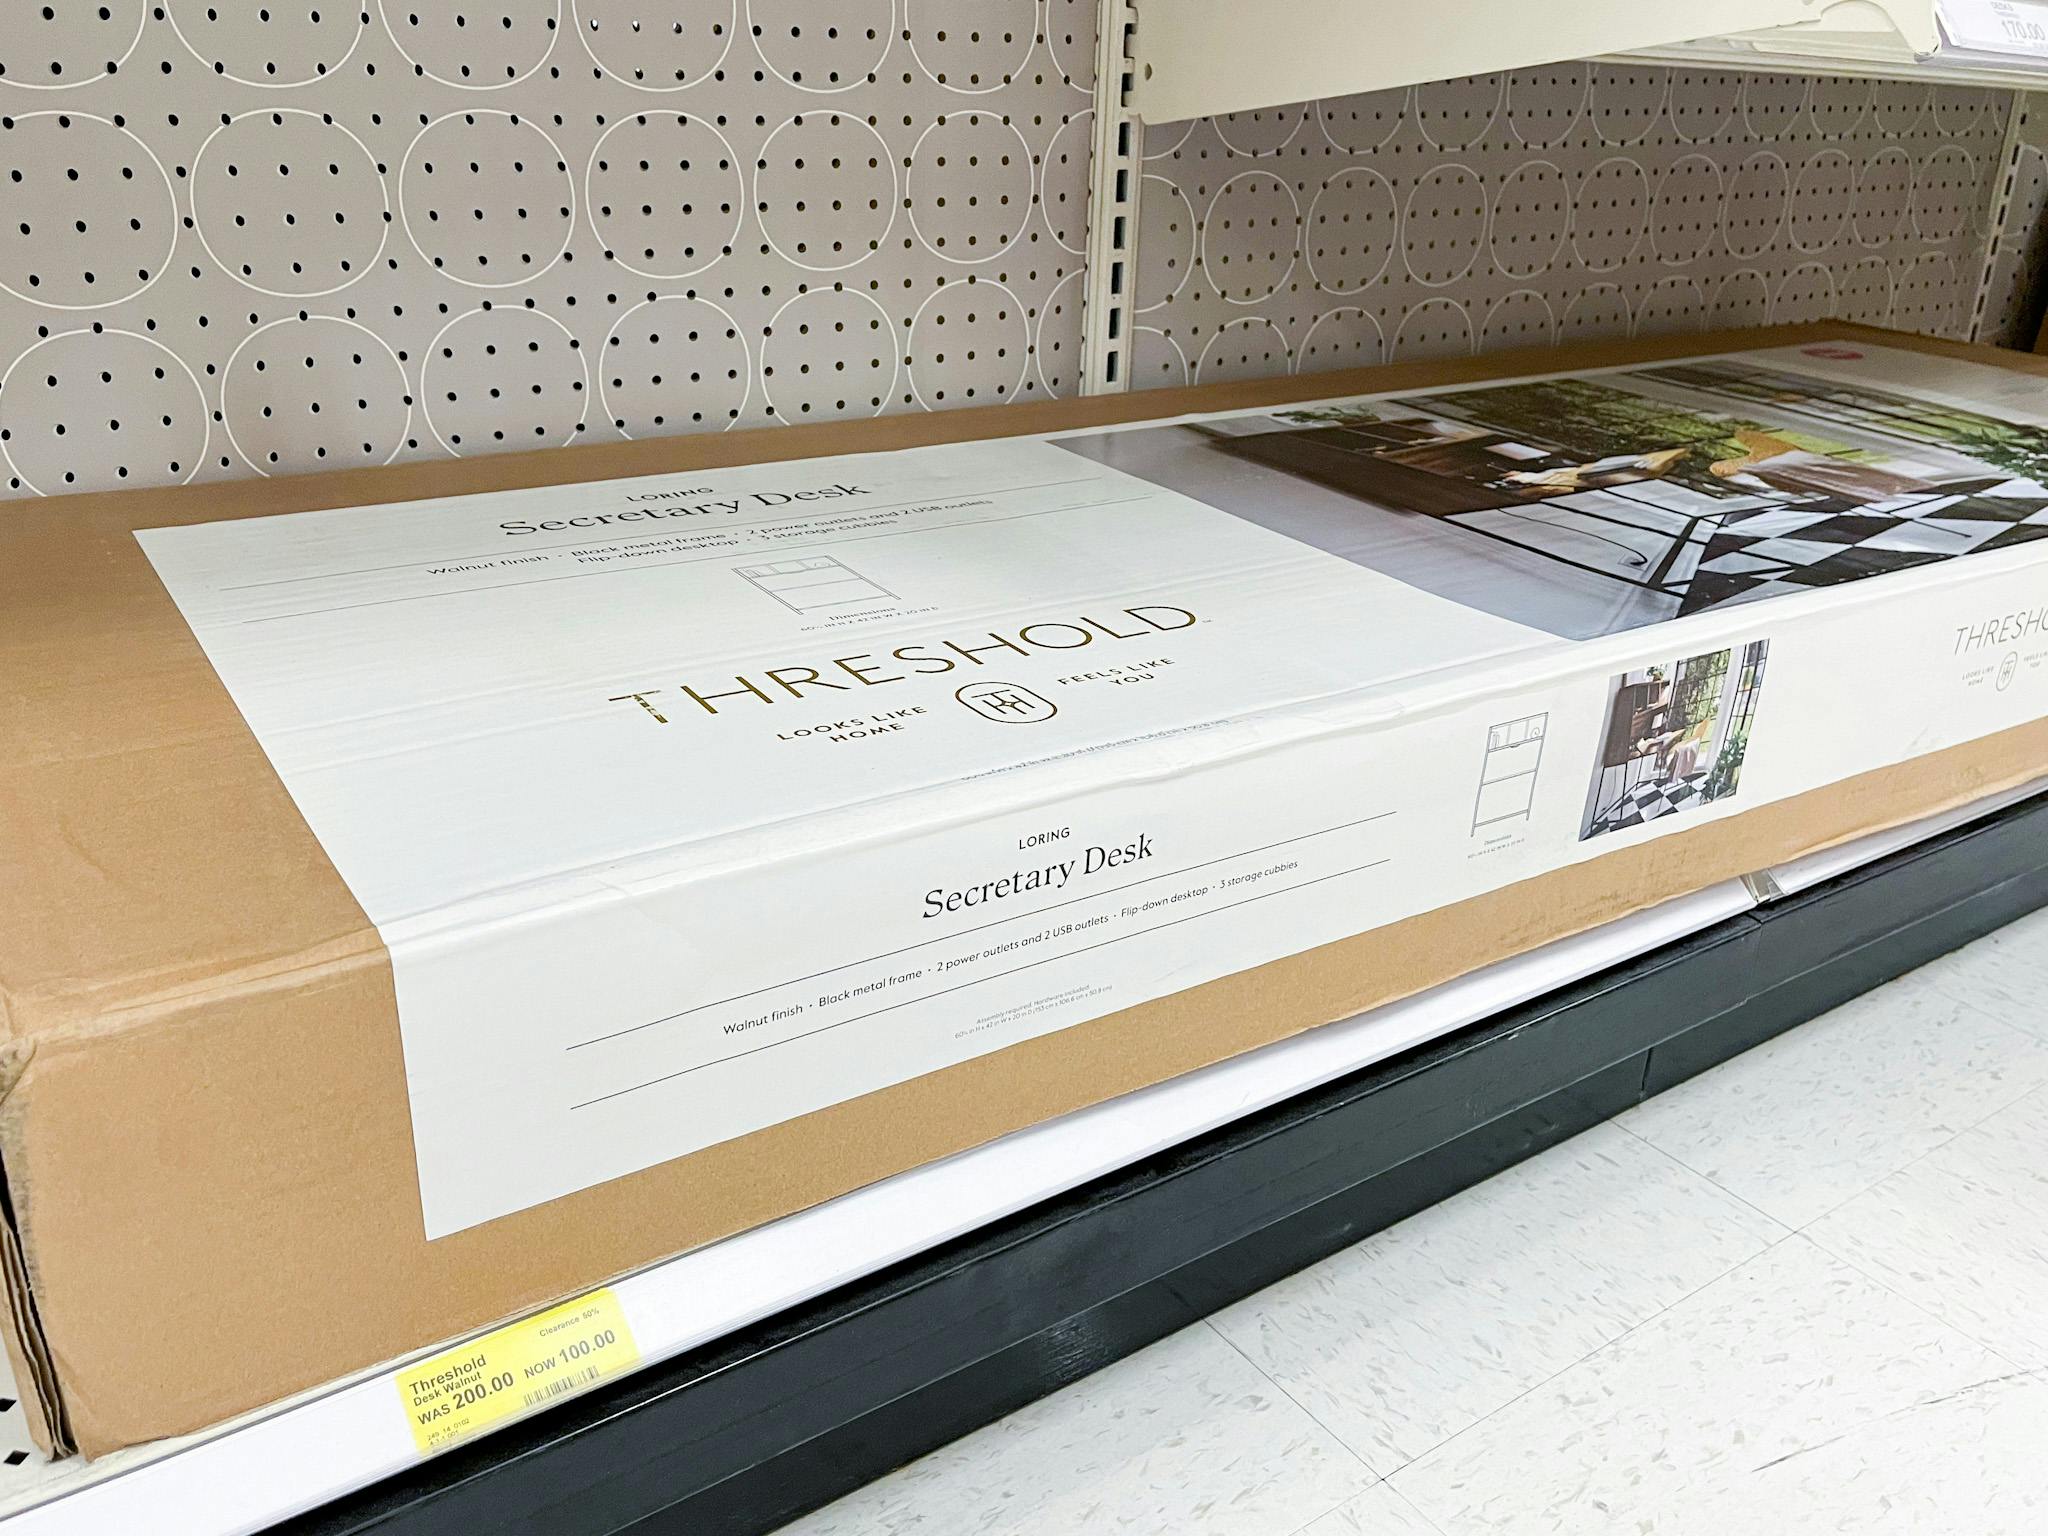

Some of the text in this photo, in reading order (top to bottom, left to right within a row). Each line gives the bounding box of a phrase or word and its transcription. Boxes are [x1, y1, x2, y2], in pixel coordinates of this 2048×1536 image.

[2000, 19, 2047, 41] 170.00
[499, 483, 872, 536] Secretary Desk
[625, 487, 714, 502] LORING
[426, 561, 495, 575] Walnut
[500, 555, 549, 567] finish
[571, 546, 618, 558] Black
[624, 539, 673, 551] metal
[675, 532, 727, 545] frame
[747, 528, 759, 536] 2
[760, 521, 810, 536] power
[814, 515, 866, 527] outlets
[869, 510, 899, 521] and
[911, 504, 944, 514] USB
[944, 499, 994, 511] outlets
[577, 547, 668, 565] Flip-down
[669, 537, 739, 553] desktop
[773, 526, 836, 541] storage
[838, 517, 899, 531] cubbies
[608, 605, 1196, 724] THRESHOLD
[1057, 656, 1176, 687] FEELS LIKE
[1108, 671, 1156, 688] YOU
[777, 705, 928, 742] LOOKS LIKE
[828, 722, 905, 744] HOME
[1019, 827, 1071, 850] LORING
[922, 832, 1154, 919] Secretary Desk
[723, 859, 1299, 1035] Walnut finish Black metal frame 2 power outlets and 2 USB outlets Flip-down desktop 3 storage cubbies
[539, 1316, 580, 1338] Clearance
[408, 1354, 487, 1395] Threshold
[413, 1371, 482, 1407] Desk Walnut
[417, 1329, 616, 1426] WAS 200.00 NOW 100.00
